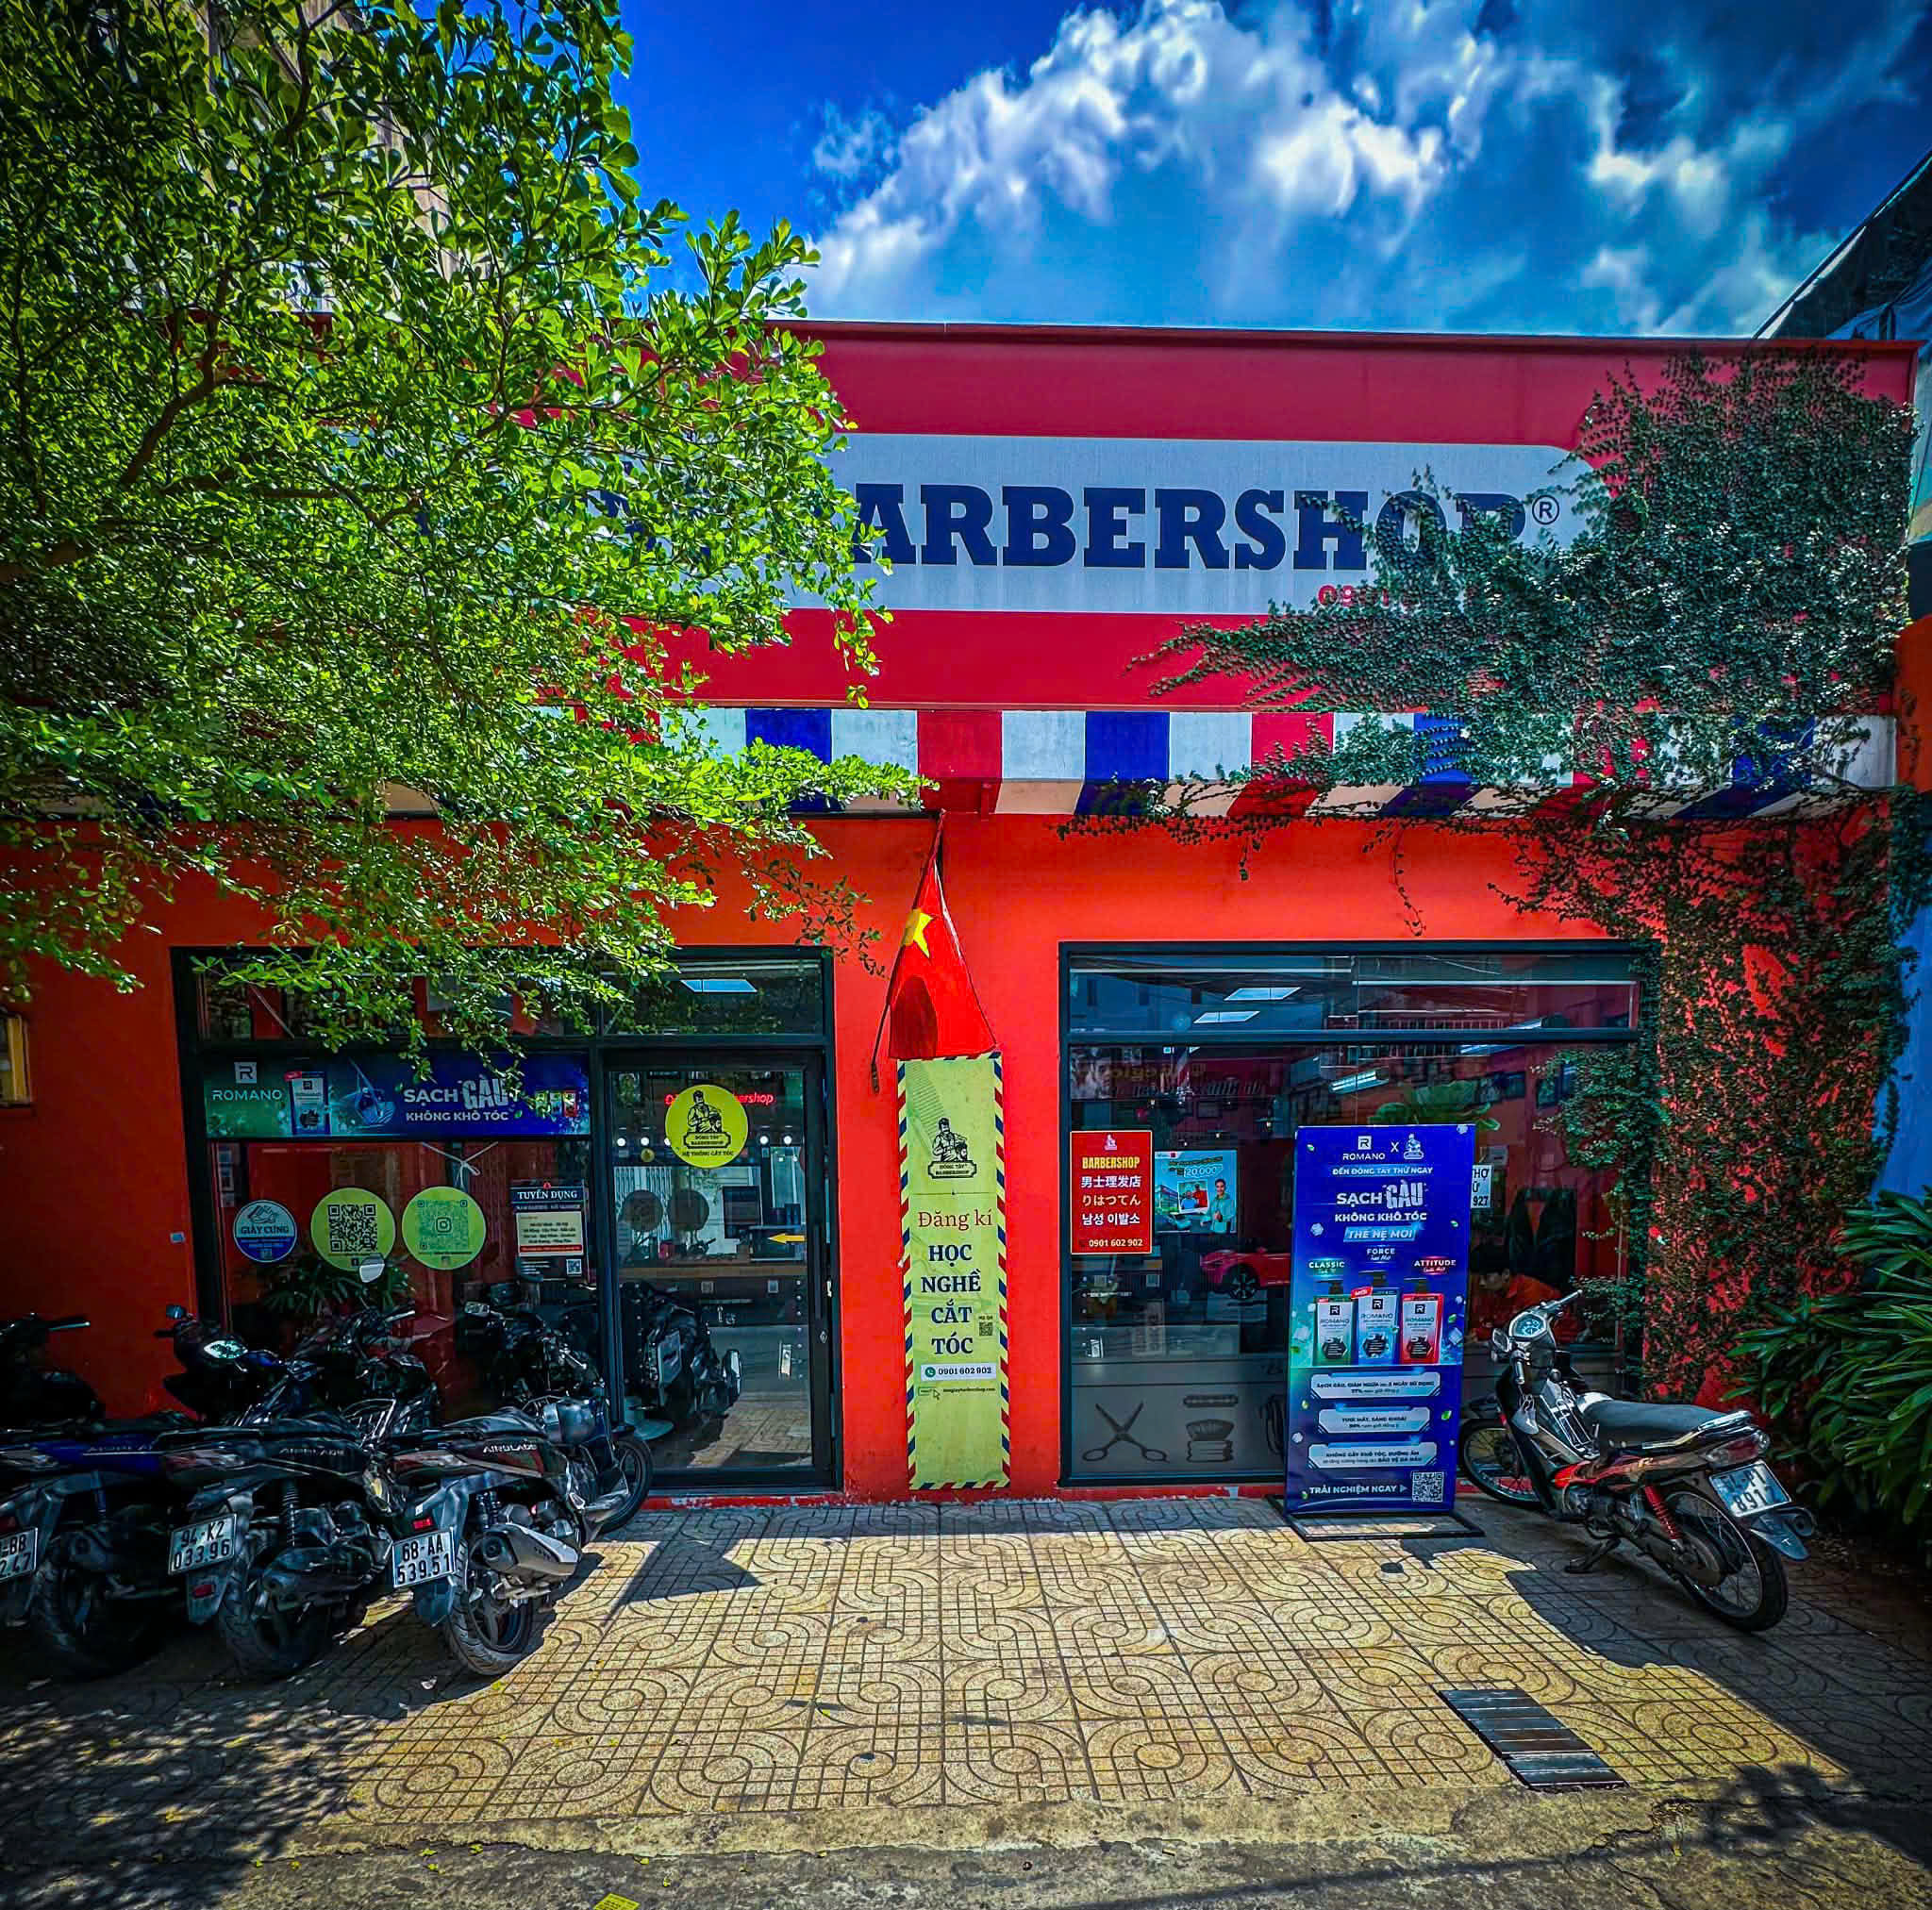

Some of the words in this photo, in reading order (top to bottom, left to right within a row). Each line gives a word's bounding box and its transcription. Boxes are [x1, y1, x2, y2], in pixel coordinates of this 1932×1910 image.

[849, 481, 1527, 572] ARBERSHOP
[211, 1089, 283, 1102] ROMANO
[404, 1088, 458, 1106] SẠCH
[1082, 1156, 1141, 1170] BARBERSHOP
[1081, 1175, 1141, 1188] 男士理发店
[1474, 1169, 1490, 1181] HỢ
[1082, 1194, 1141, 1206] りはつてん
[1337, 1192, 1383, 1208] SẠCH
[1473, 1196, 1489, 1206] 927
[918, 1209, 970, 1231] Đăng
[974, 1208, 993, 1226] kí
[1082, 1213, 1105, 1226] 남성
[1108, 1213, 1141, 1226] 이발소
[1335, 1211, 1375, 1222] KHÔNG
[1405, 1210, 1427, 1221] TÓC
[1089, 1238, 1108, 1247] 0901
[1110, 1238, 1126, 1247] 602
[928, 1244, 973, 1267] HỌC
[921, 1269, 982, 1293] NGHỀ
[931, 1298, 973, 1324] CẮT
[931, 1331, 974, 1354] TÓC
[1309, 1485, 1331, 1494] TRẢI
[1332, 1485, 1370, 1495] NGHIỆM
[1371, 1485, 1397, 1493] NGAY
[175, 1539, 230, 1570] 033.96
[403, 1534, 443, 1562] 68-AA
[397, 1553, 450, 1585] 539.51
